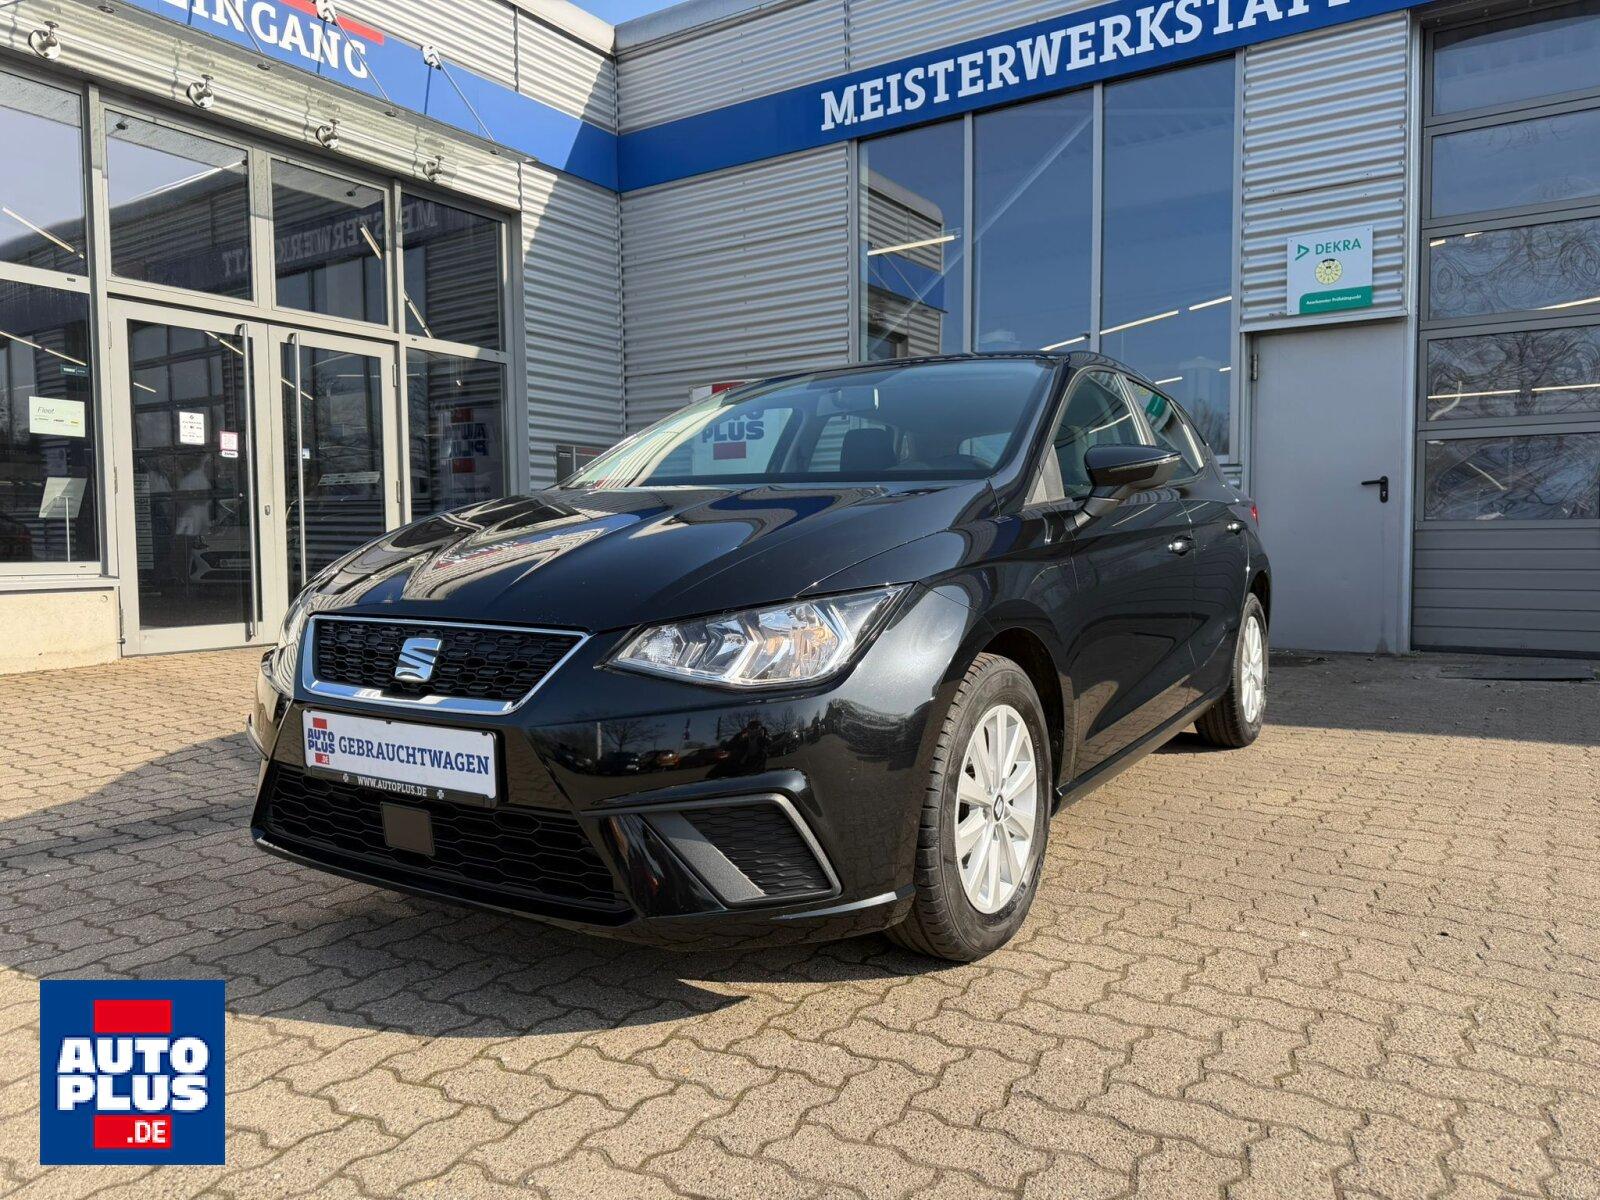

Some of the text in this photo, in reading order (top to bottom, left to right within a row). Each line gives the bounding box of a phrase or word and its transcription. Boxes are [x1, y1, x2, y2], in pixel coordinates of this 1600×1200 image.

[158, 0, 368, 79] NGANG
[820, 0, 1350, 132] MEISTERWERKSTA
[1315, 238, 1361, 255] DEKRA
[702, 421, 764, 443] PLUS
[307, 728, 335, 743] AUTO
[307, 739, 336, 754] PLUS
[338, 736, 490, 775] GEBRAUCHTWAGEN
[357, 776, 428, 797] WWW.AUTOPLUS.DE
